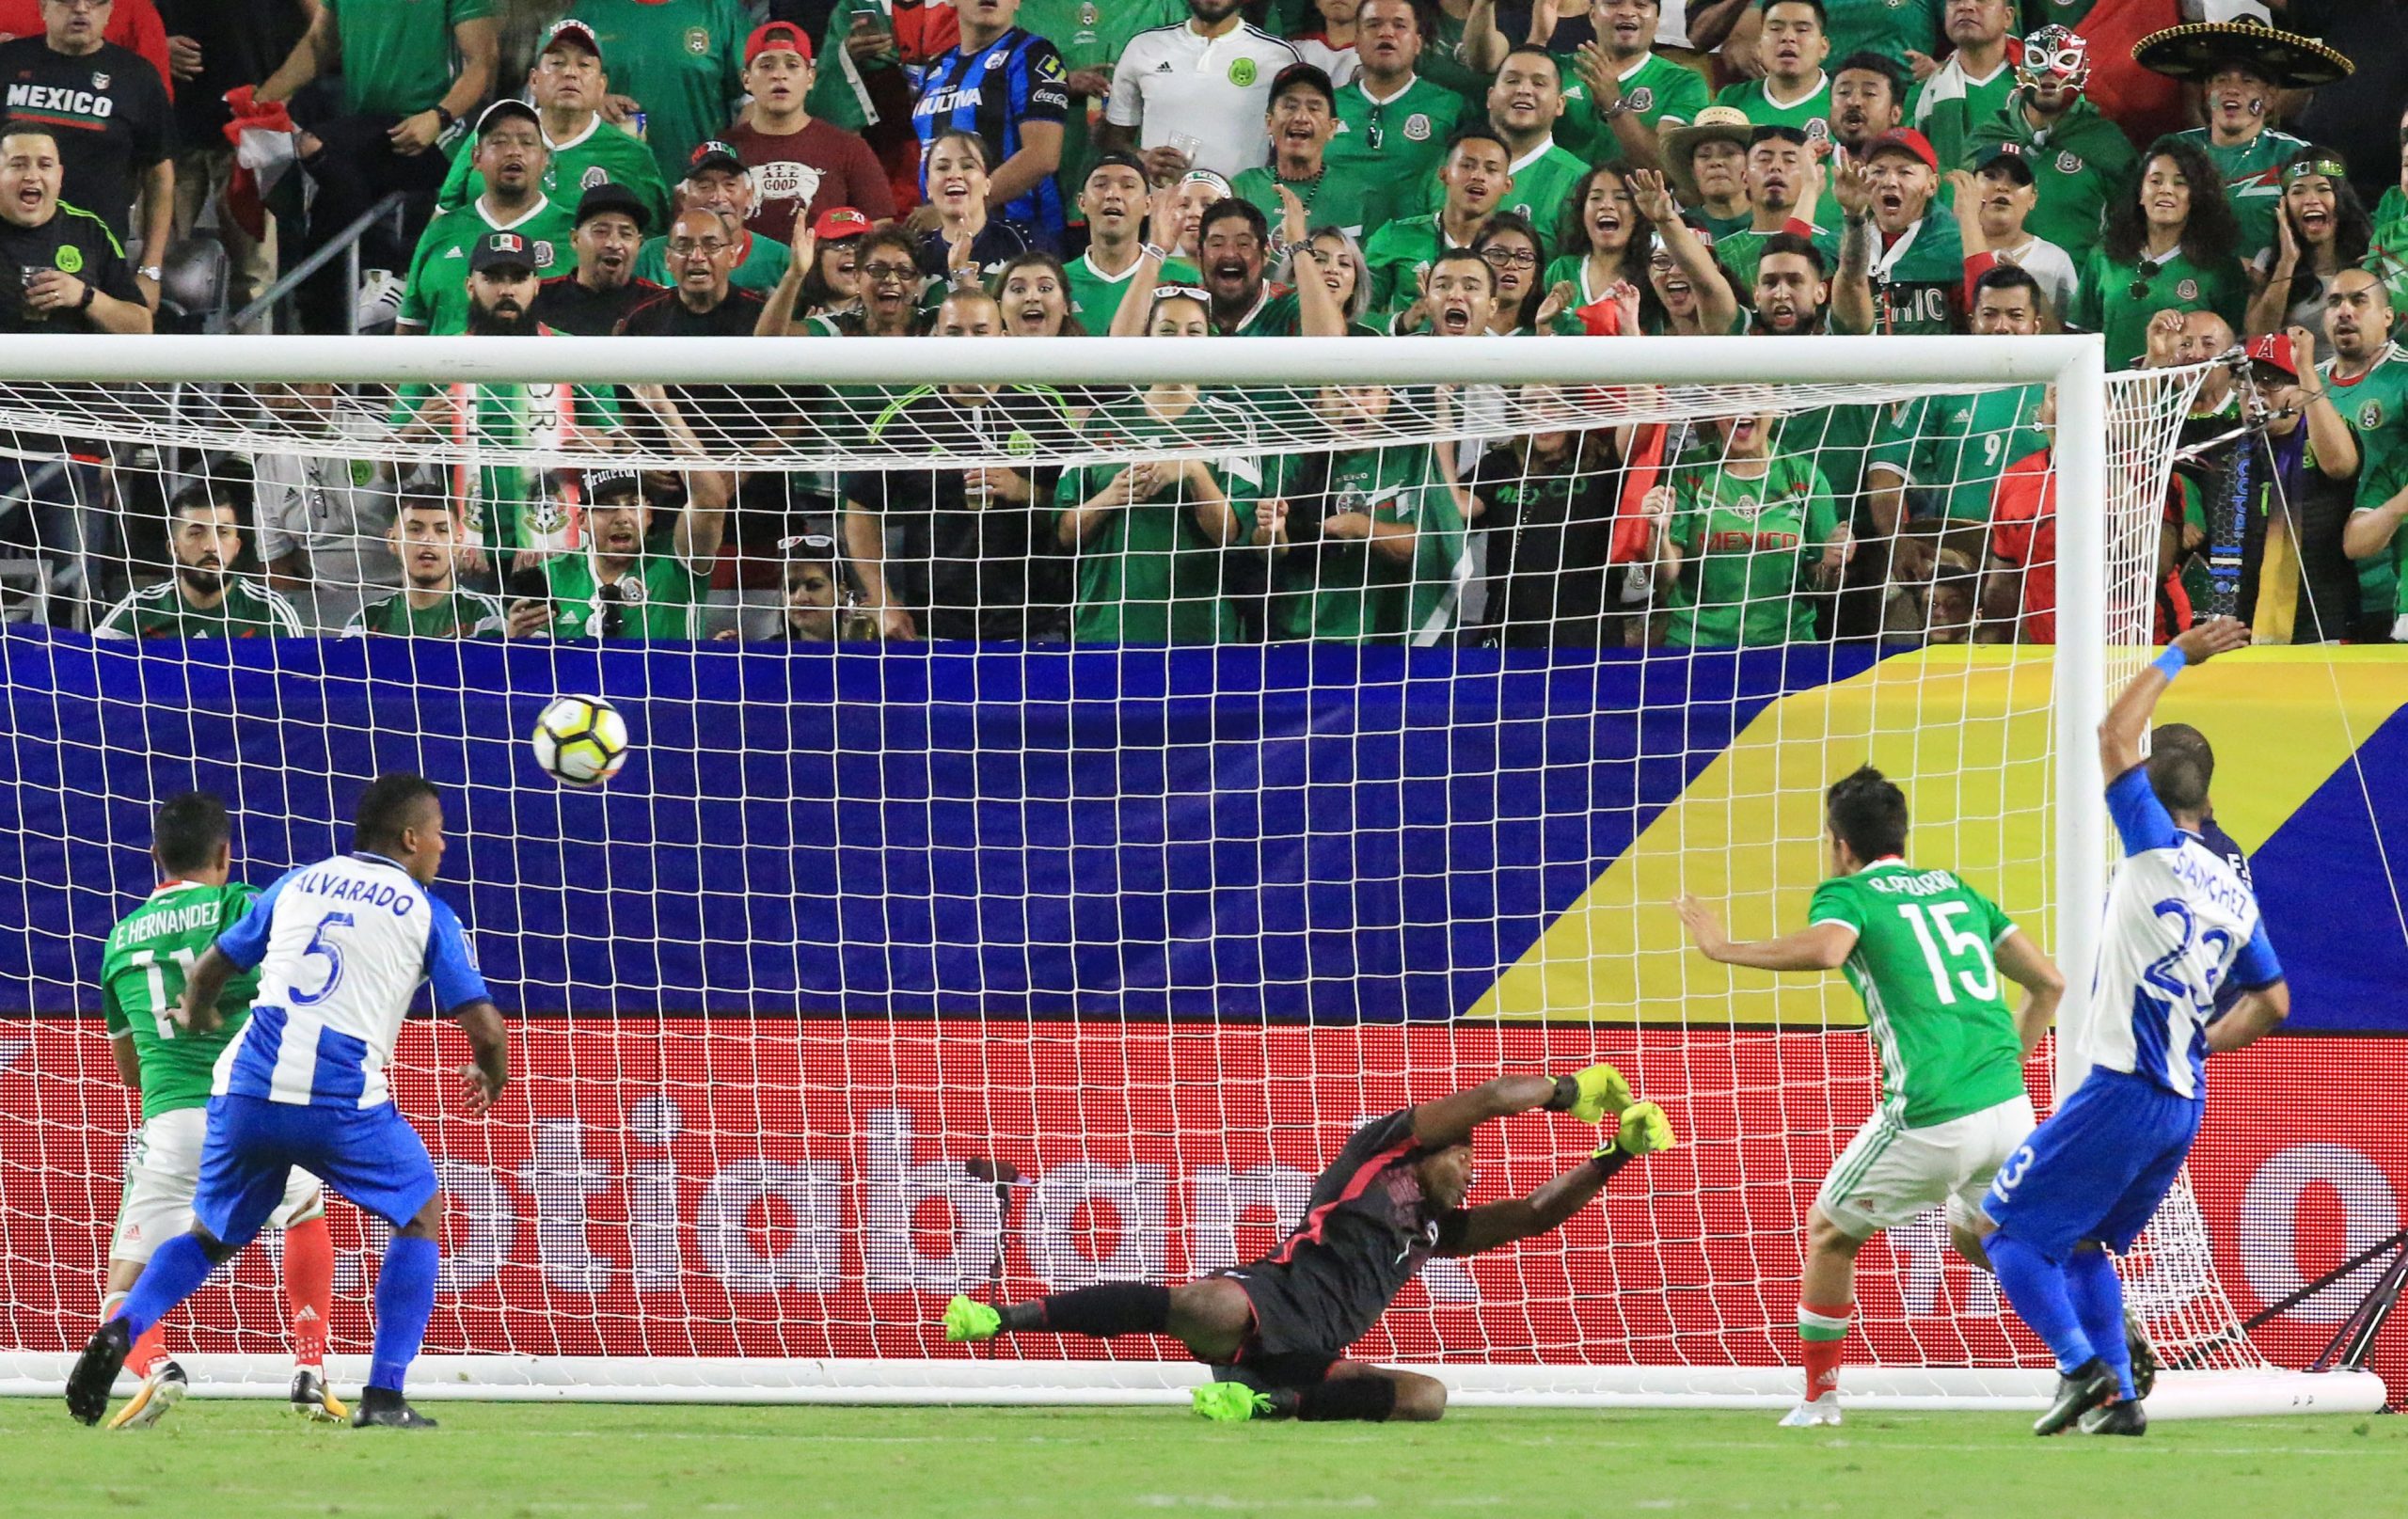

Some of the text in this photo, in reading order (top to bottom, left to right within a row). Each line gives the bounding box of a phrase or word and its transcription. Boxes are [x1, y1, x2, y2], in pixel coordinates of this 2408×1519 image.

[7, 84, 113, 118] MEXICO
[691, 140, 737, 166] MEXICO
[764, 179, 799, 191] GOOD
[1984, 434, 2002, 467] 9
[296, 871, 414, 917] ALVARADO
[288, 910, 355, 1006] 5
[1896, 900, 1997, 1005] 15
